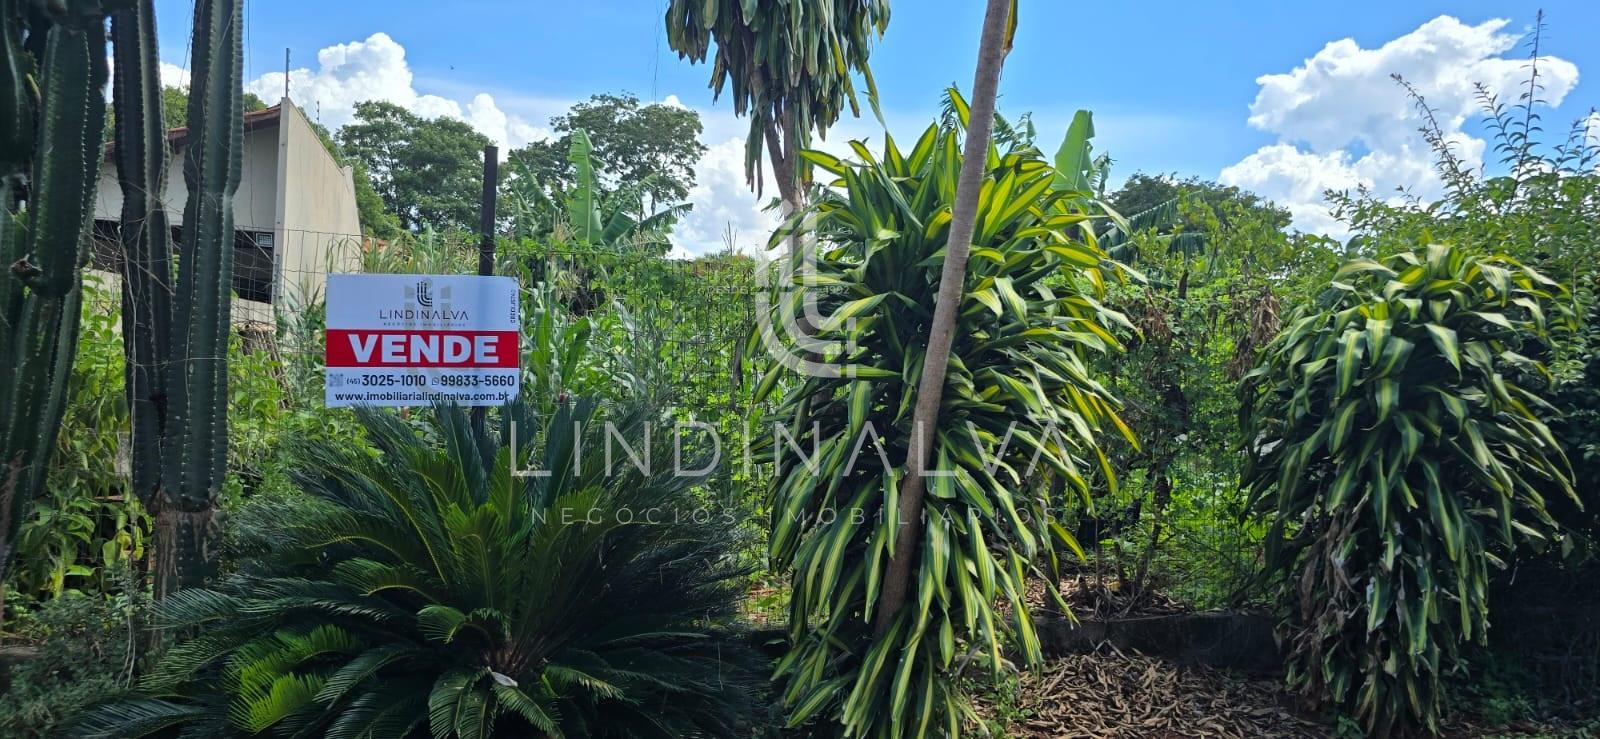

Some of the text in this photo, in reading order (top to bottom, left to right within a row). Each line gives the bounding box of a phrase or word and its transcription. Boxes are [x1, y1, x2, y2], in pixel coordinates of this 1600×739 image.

[379, 309, 469, 321] LINDINALVA
[347, 333, 500, 364] VENDE
[346, 374, 515, 387] (45) 3025-1010 99833-5660
[335, 390, 510, 401] www.imobiliarialindinalva.com.br
